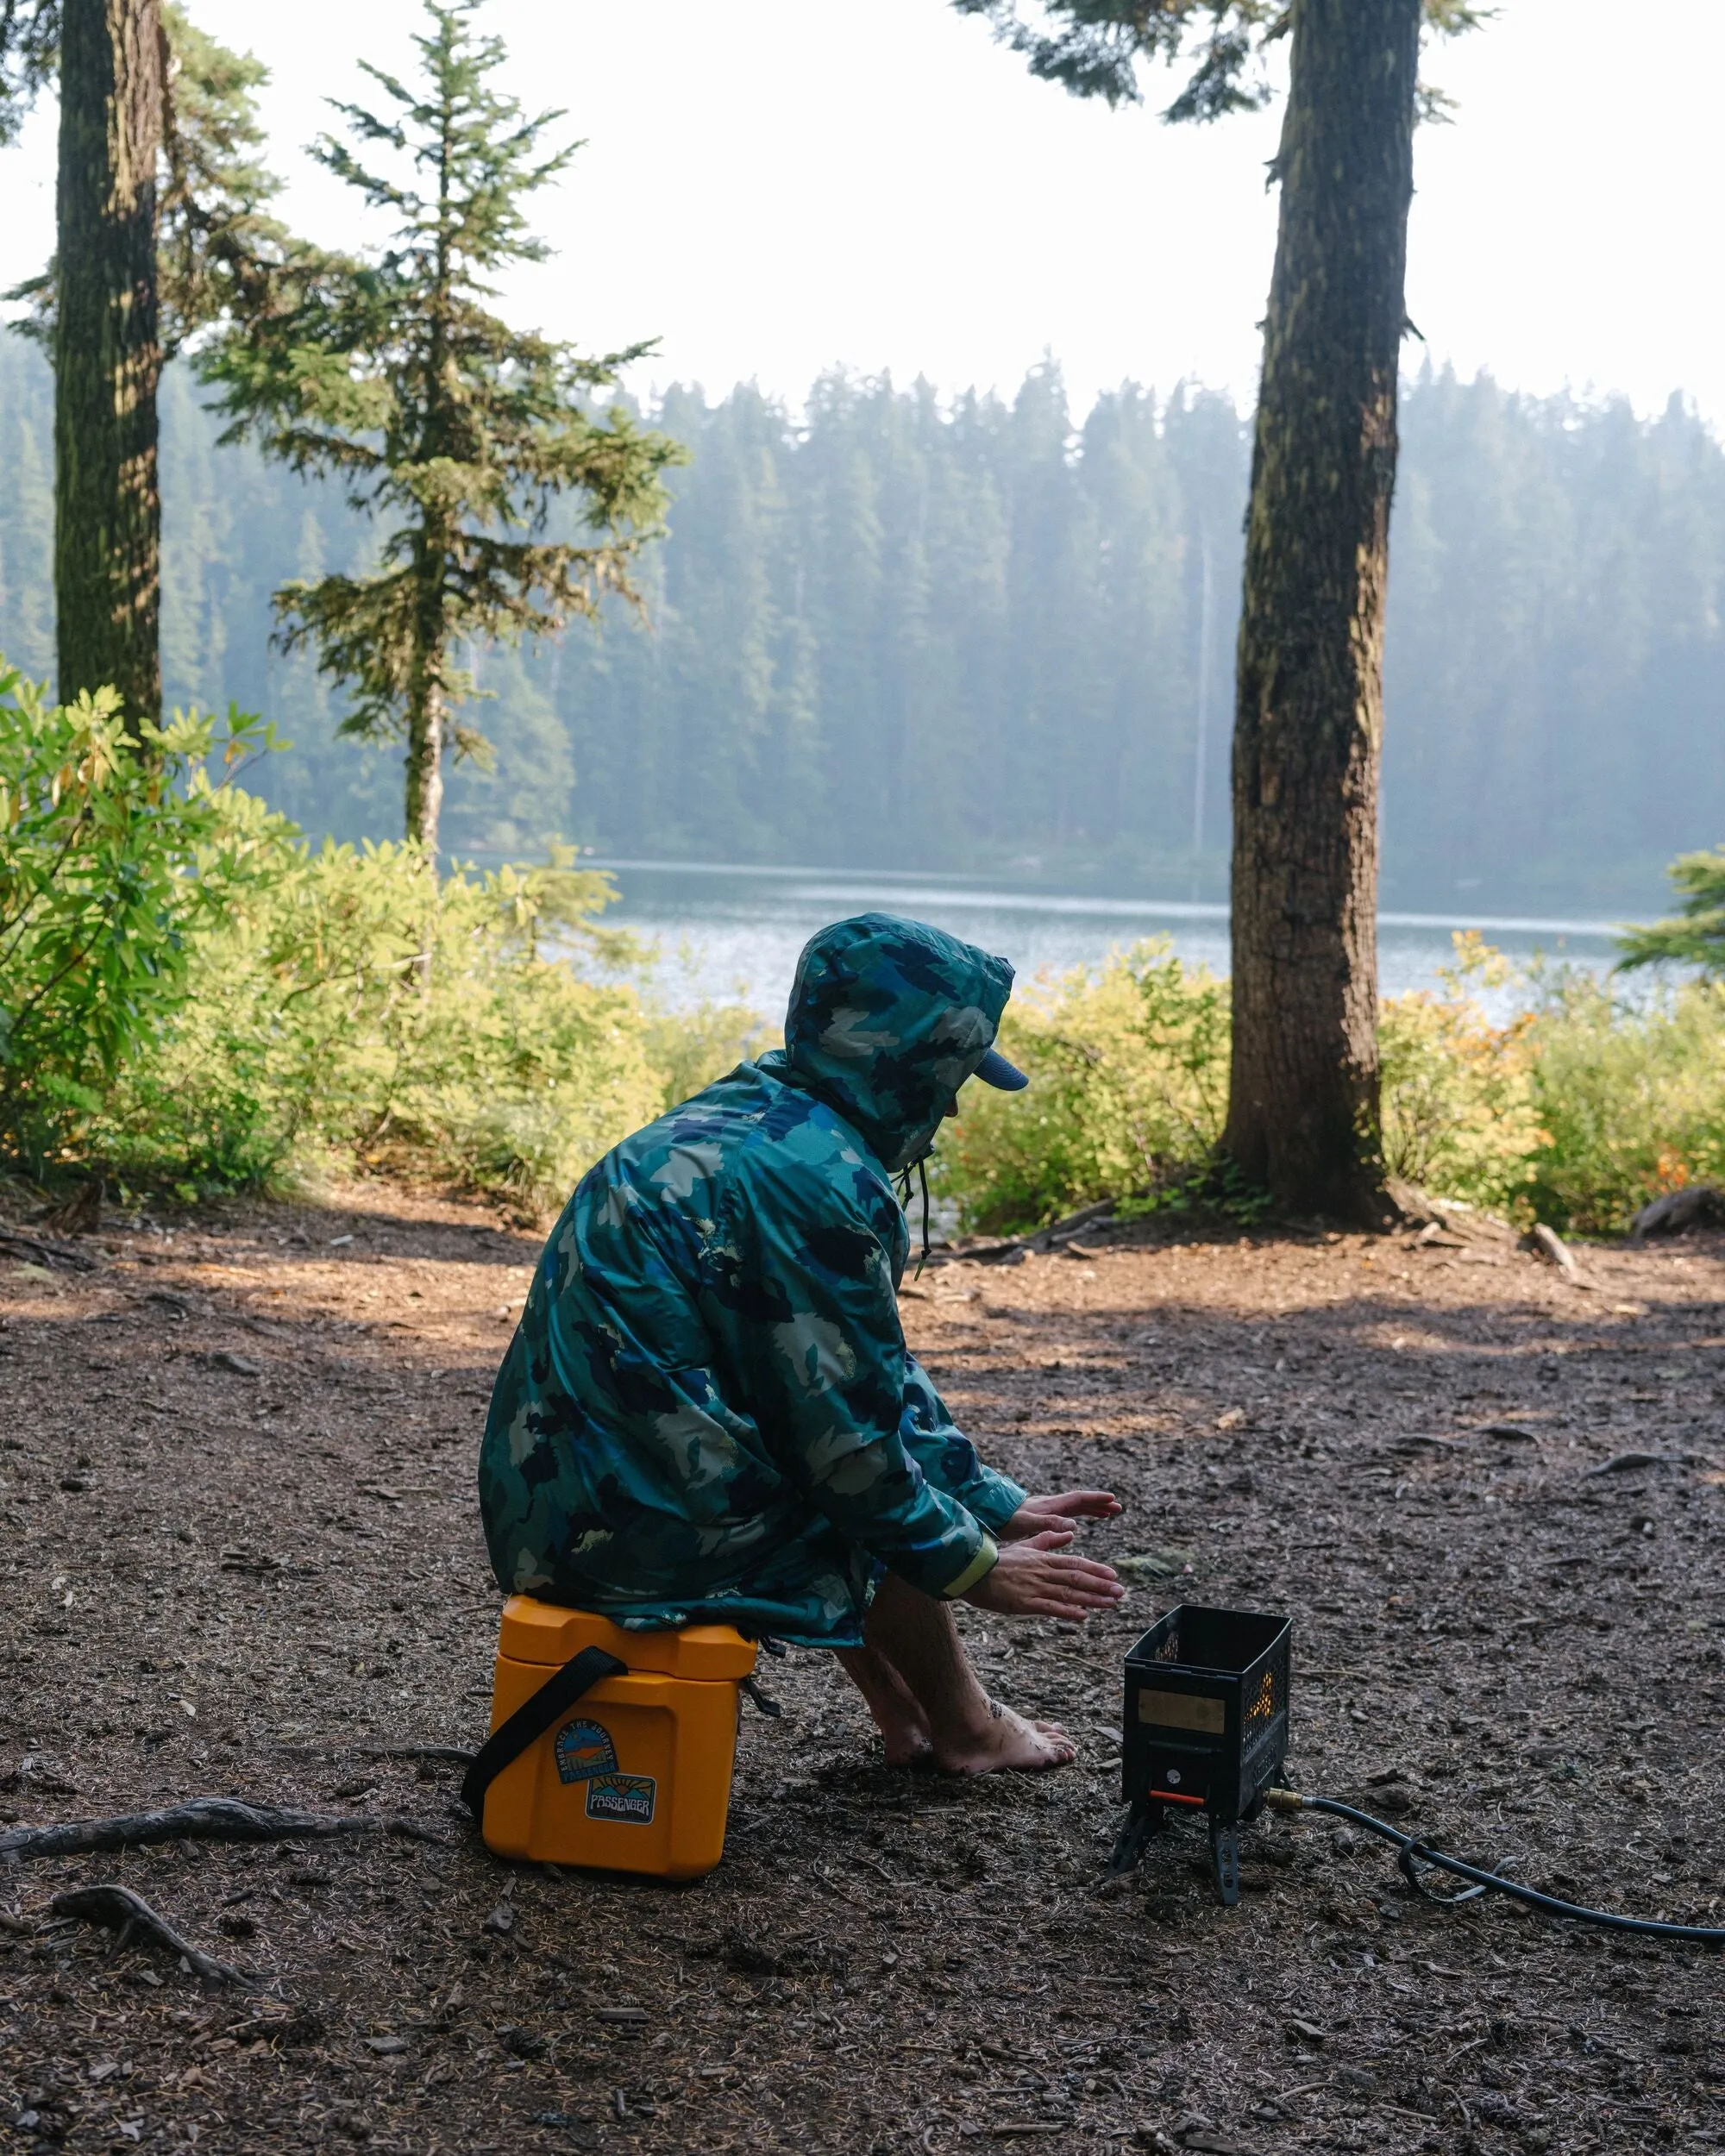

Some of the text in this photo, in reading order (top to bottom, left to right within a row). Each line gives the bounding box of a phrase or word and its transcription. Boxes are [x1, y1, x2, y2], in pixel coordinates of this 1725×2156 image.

[556, 1720, 614, 1771] EMBRACE THE JOURNEY
[590, 1794, 649, 1816] PASSENGER
